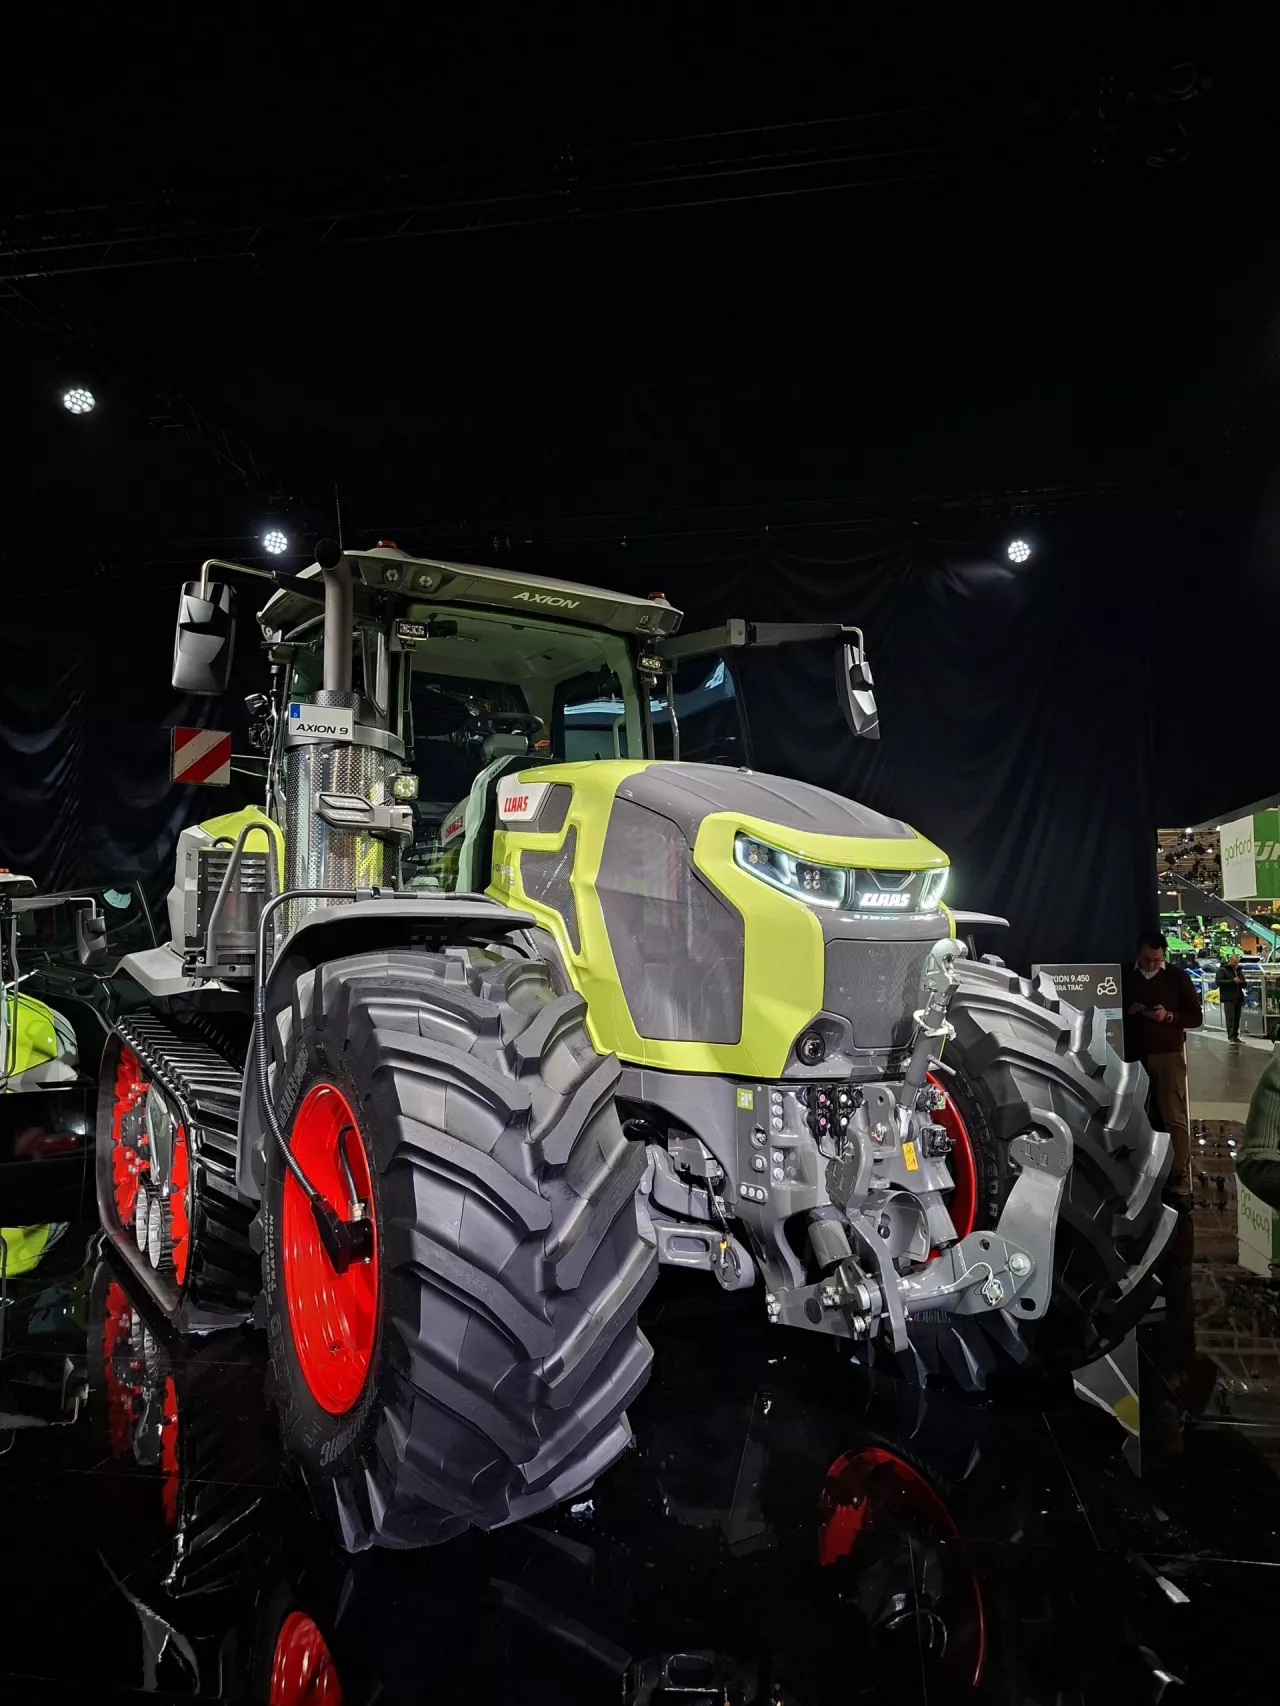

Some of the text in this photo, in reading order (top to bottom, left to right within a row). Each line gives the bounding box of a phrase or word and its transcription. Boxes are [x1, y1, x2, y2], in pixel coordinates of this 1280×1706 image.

[512, 592, 580, 609] AXION
[296, 723, 349, 735] AXION 9
[503, 796, 529, 813] CLAAS
[1224, 833, 1252, 866] garford
[860, 893, 911, 908] CLAAS
[1070, 974, 1090, 982] 9.450
[1067, 983, 1084, 991] TRAC
[268, 1212, 277, 1291] TRACTION
